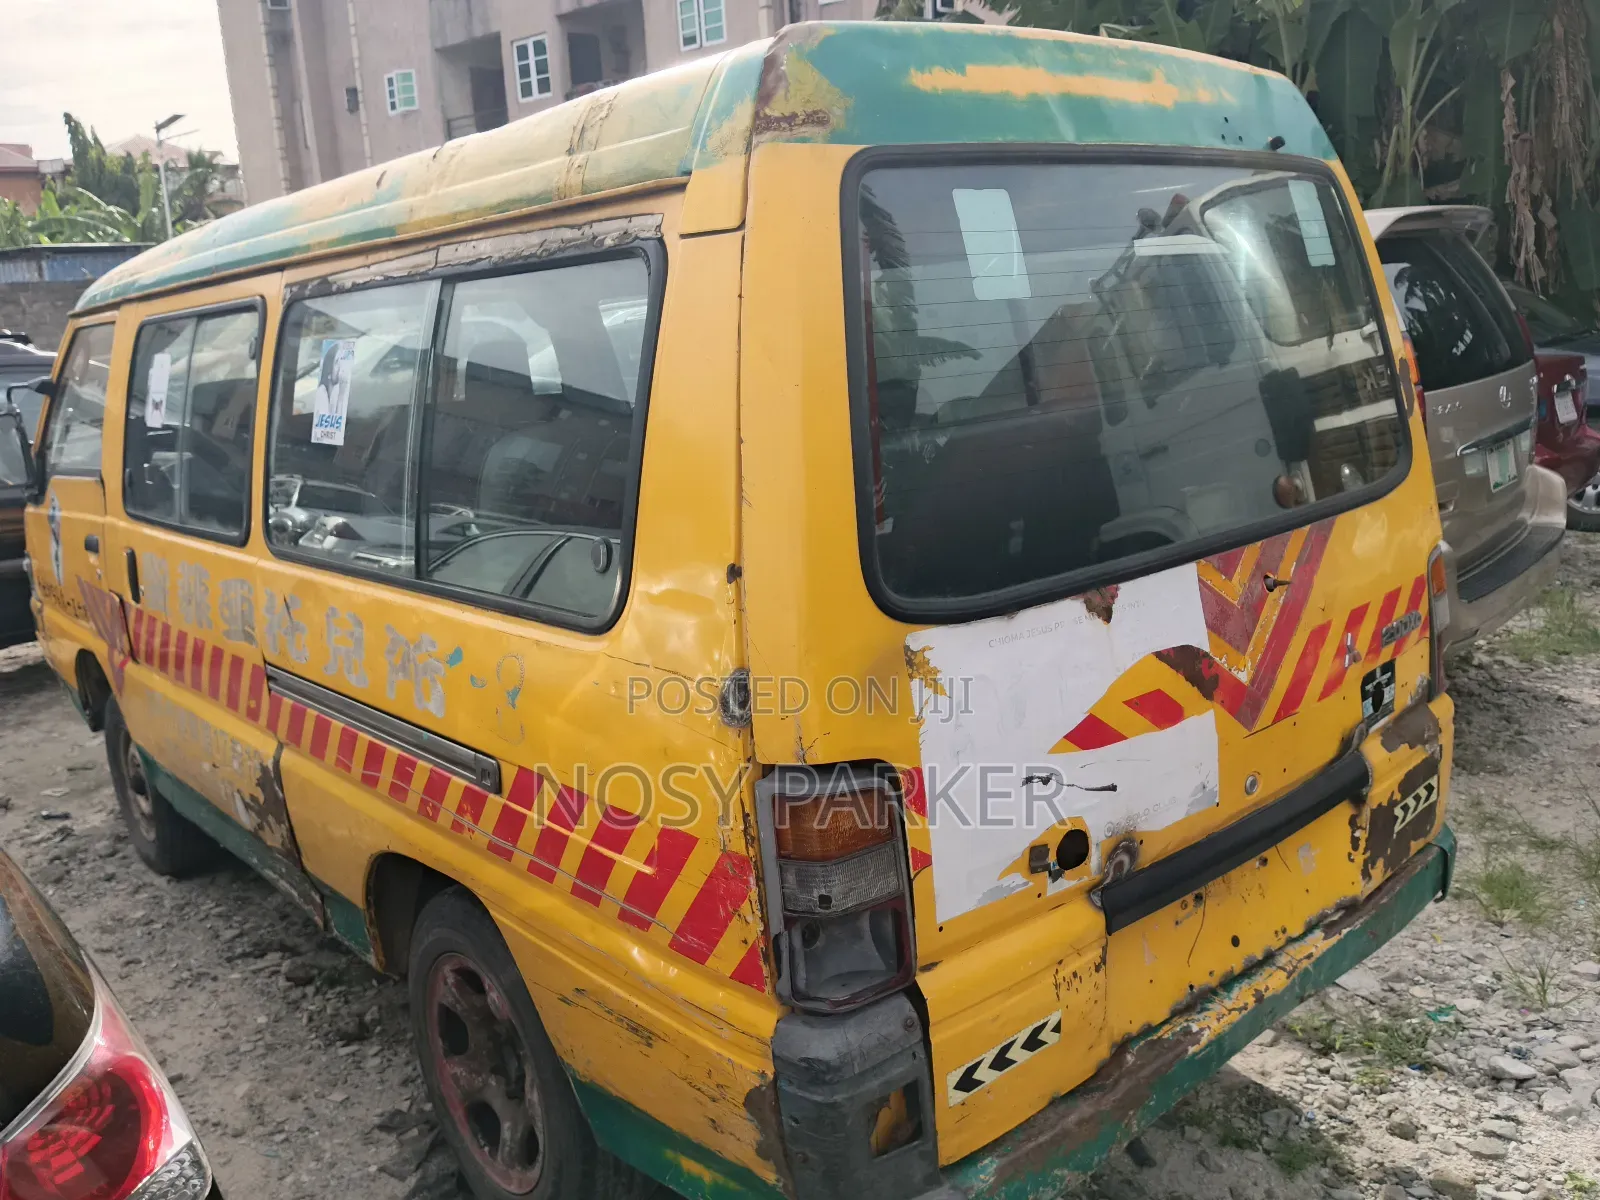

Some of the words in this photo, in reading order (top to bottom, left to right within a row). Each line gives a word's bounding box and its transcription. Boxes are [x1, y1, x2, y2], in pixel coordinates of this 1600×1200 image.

[315, 414, 343, 430] JESUS
[320, 430, 337, 440] CHRIST
[1026, 624, 1053, 641] JESUS
